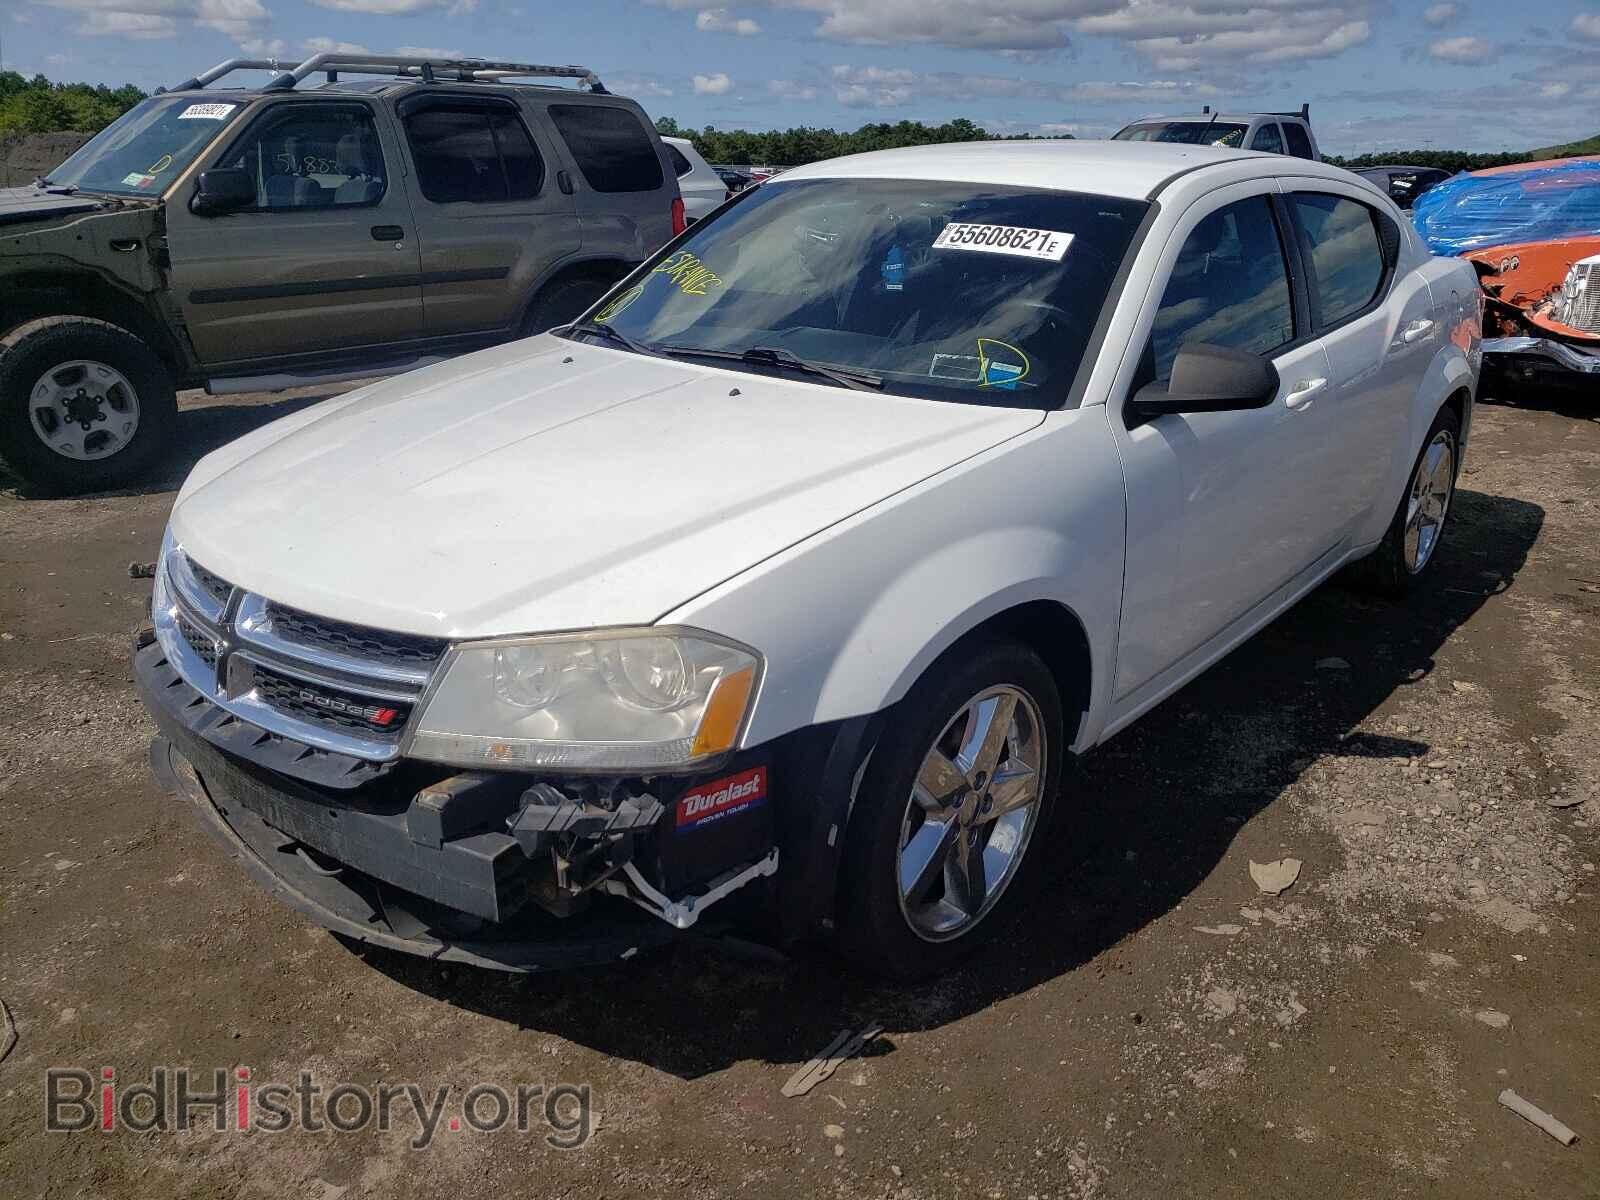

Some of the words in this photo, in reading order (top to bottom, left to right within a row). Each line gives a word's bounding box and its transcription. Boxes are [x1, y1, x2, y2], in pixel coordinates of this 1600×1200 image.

[950, 223, 1052, 251] 55608621
[1046, 241, 1059, 253] E
[299, 689, 380, 720] DODGE
[682, 773, 760, 817] Duralast
